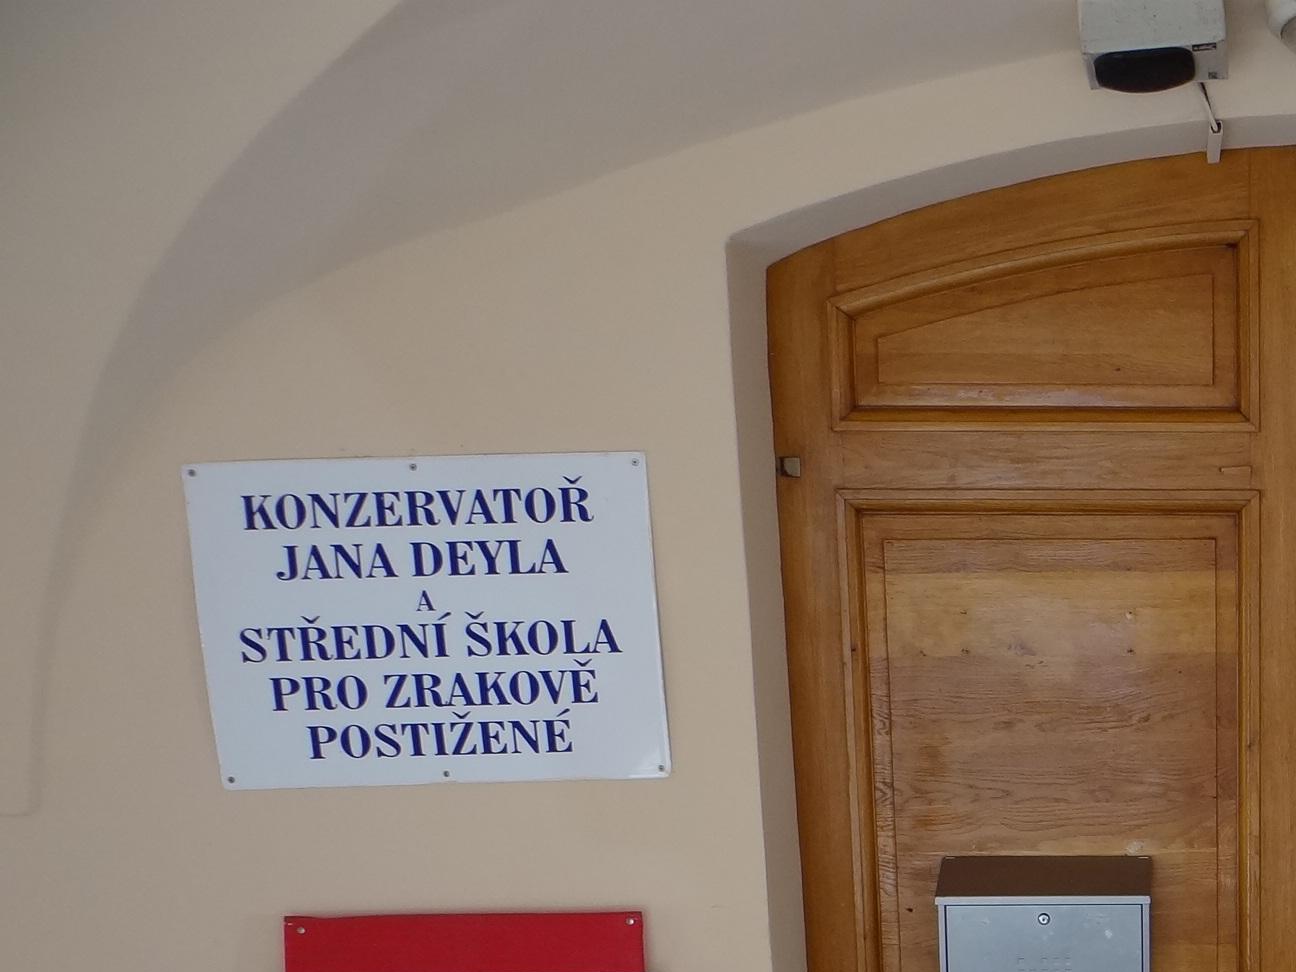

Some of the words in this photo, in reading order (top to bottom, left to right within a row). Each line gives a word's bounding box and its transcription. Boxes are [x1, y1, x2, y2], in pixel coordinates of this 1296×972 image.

[241, 475, 594, 531] KONZERVATOŘ
[276, 544, 399, 581] JANA
[409, 538, 569, 577] DEYLA
[416, 590, 436, 612] A
[240, 612, 452, 664] STŘEDNÍ
[465, 611, 623, 657] ŠKOLA
[270, 674, 368, 712] PRO
[383, 659, 600, 708] ZRAKOVĚ
[308, 708, 574, 760] POSTIŽENÉ
